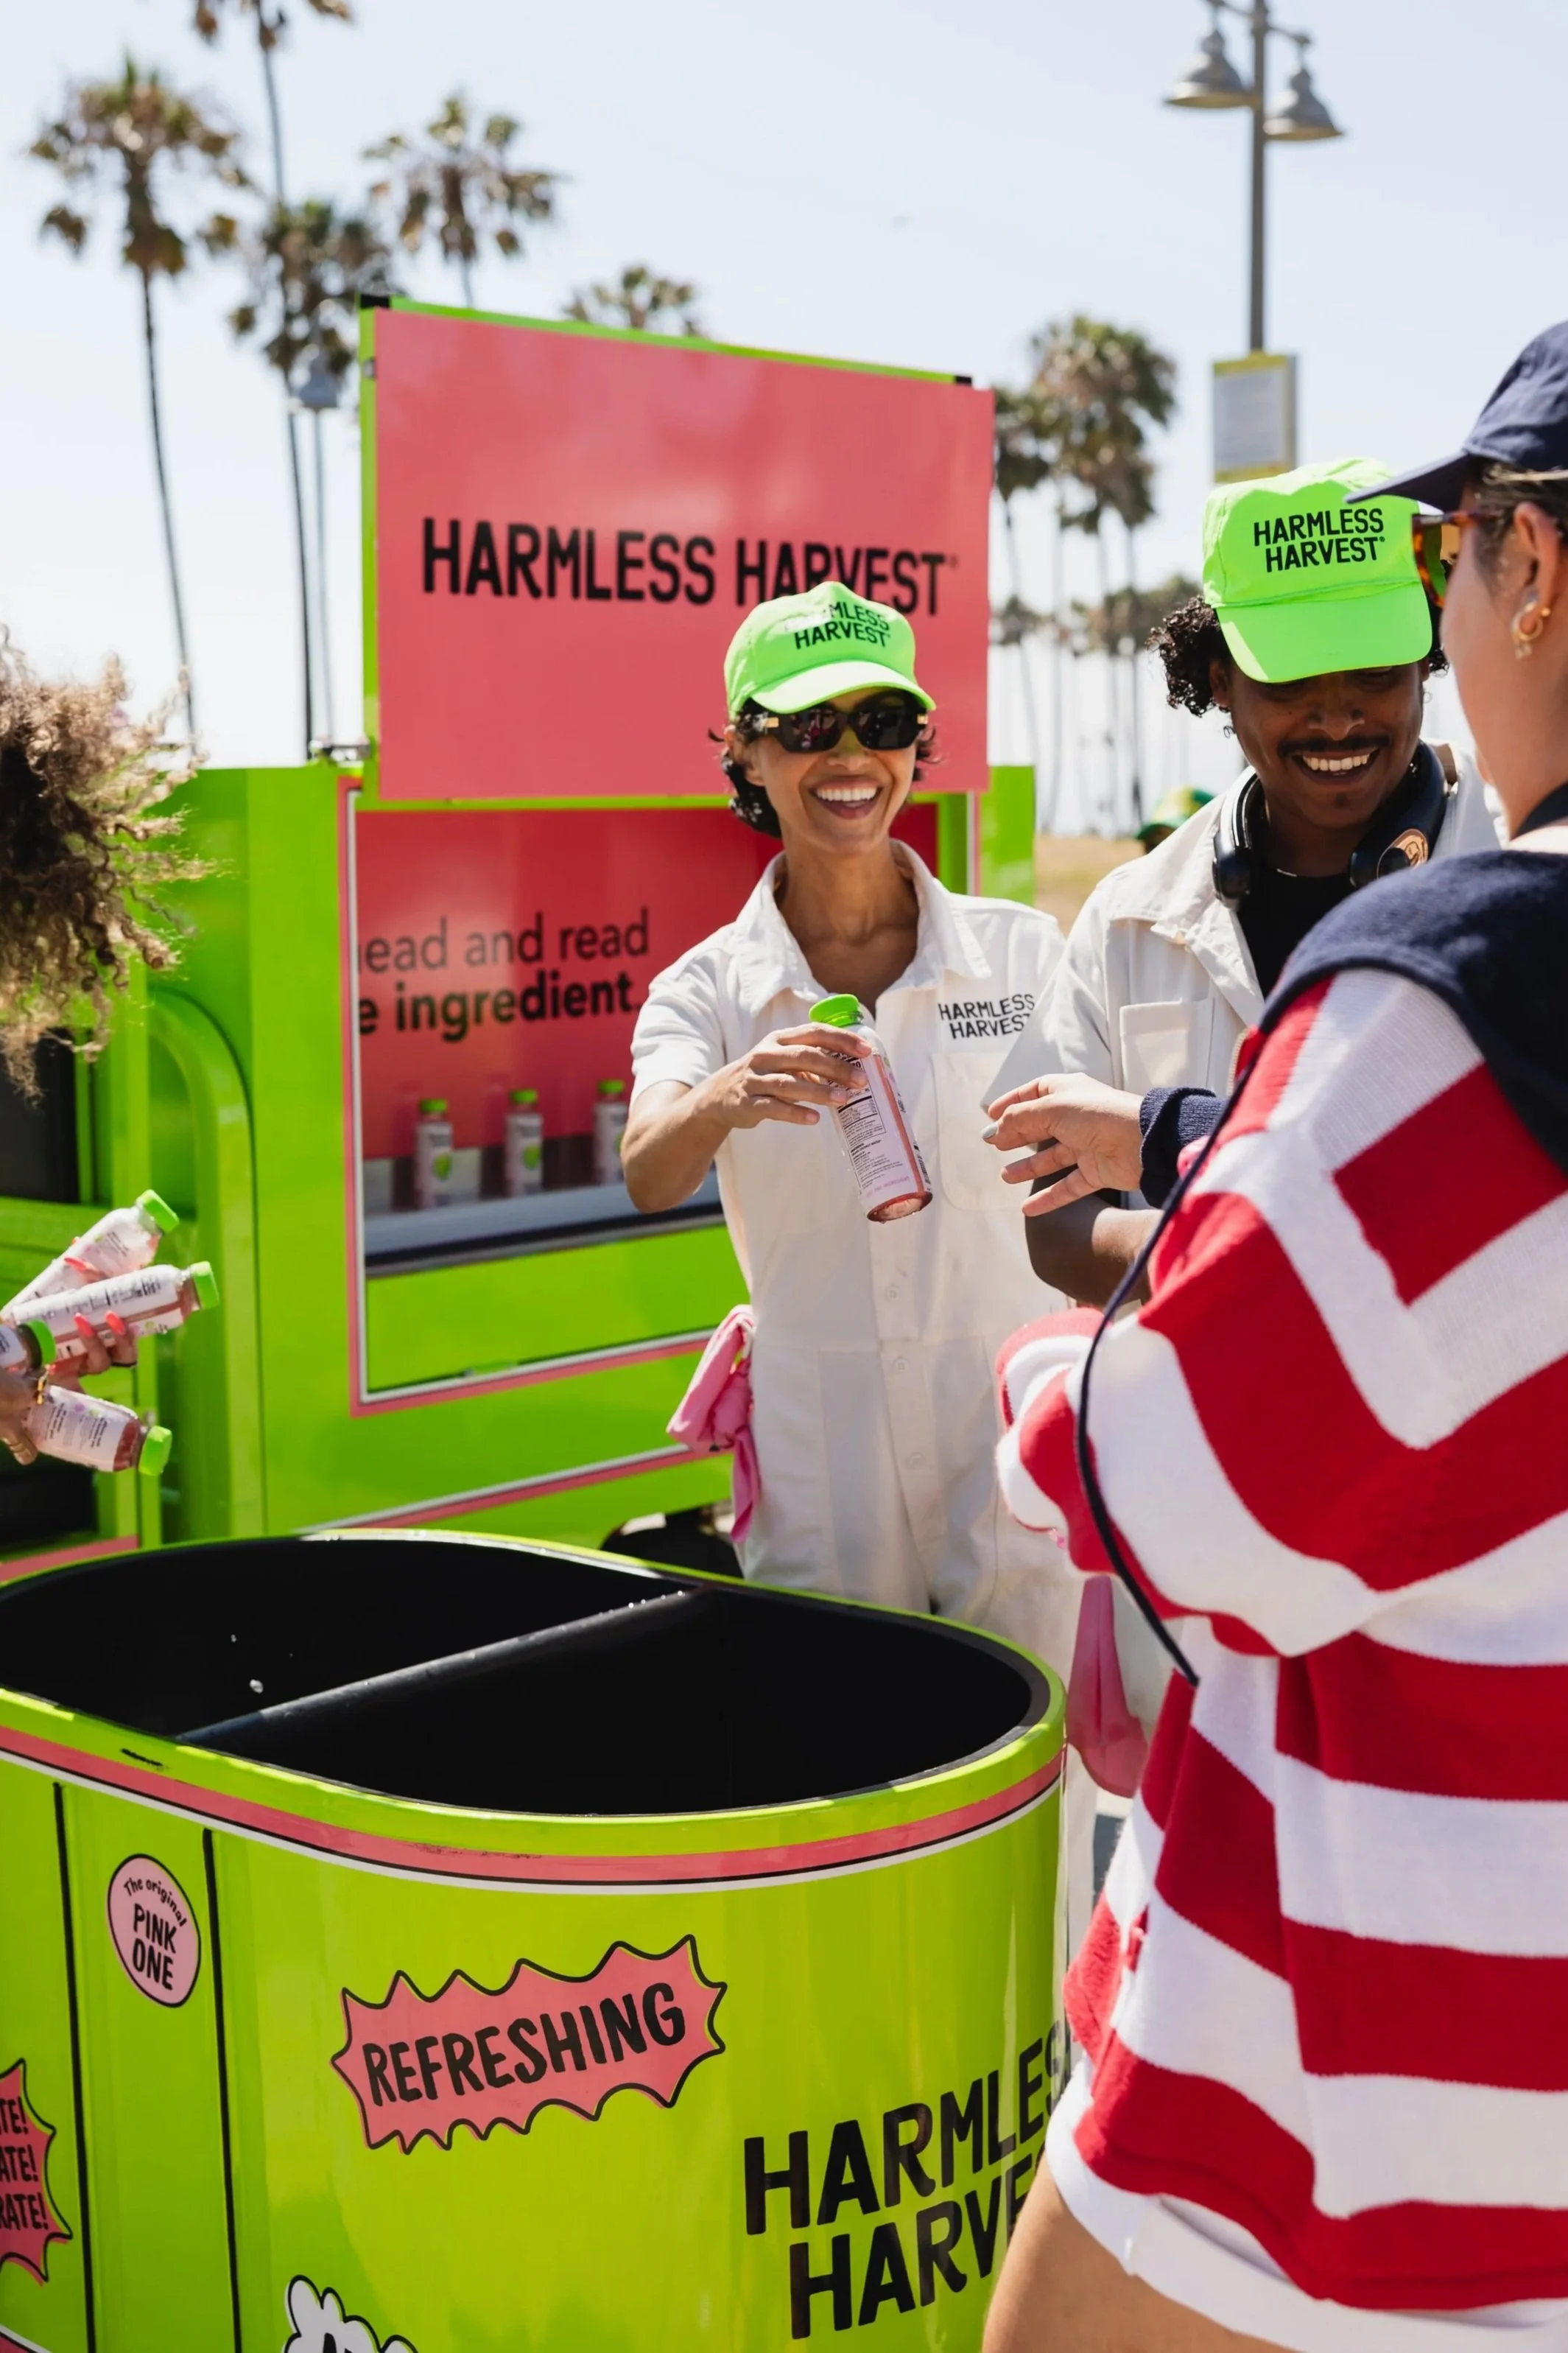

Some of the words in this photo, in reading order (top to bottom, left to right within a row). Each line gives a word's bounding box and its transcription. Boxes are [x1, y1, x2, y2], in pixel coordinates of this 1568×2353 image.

[1254, 508, 1384, 547] HARMLESS
[423, 517, 715, 606] HARMLESS
[822, 601, 890, 631] MLESS
[358, 916, 449, 974] ead
[465, 911, 544, 967] and
[560, 906, 650, 961] read
[937, 993, 1036, 1021] HARMLESS
[949, 1014, 1031, 1039] HARVES
[123, 1877, 144, 1897] The
[145, 1879, 188, 1927] original
[133, 1902, 177, 1954] PINK
[133, 1937, 174, 1991] ONE
[362, 1982, 686, 2107] REFRESHING
[0, 2096, 29, 2135] TE!
[743, 2019, 1072, 2236] HARMLES
[789, 2140, 1046, 2340] HARVE
